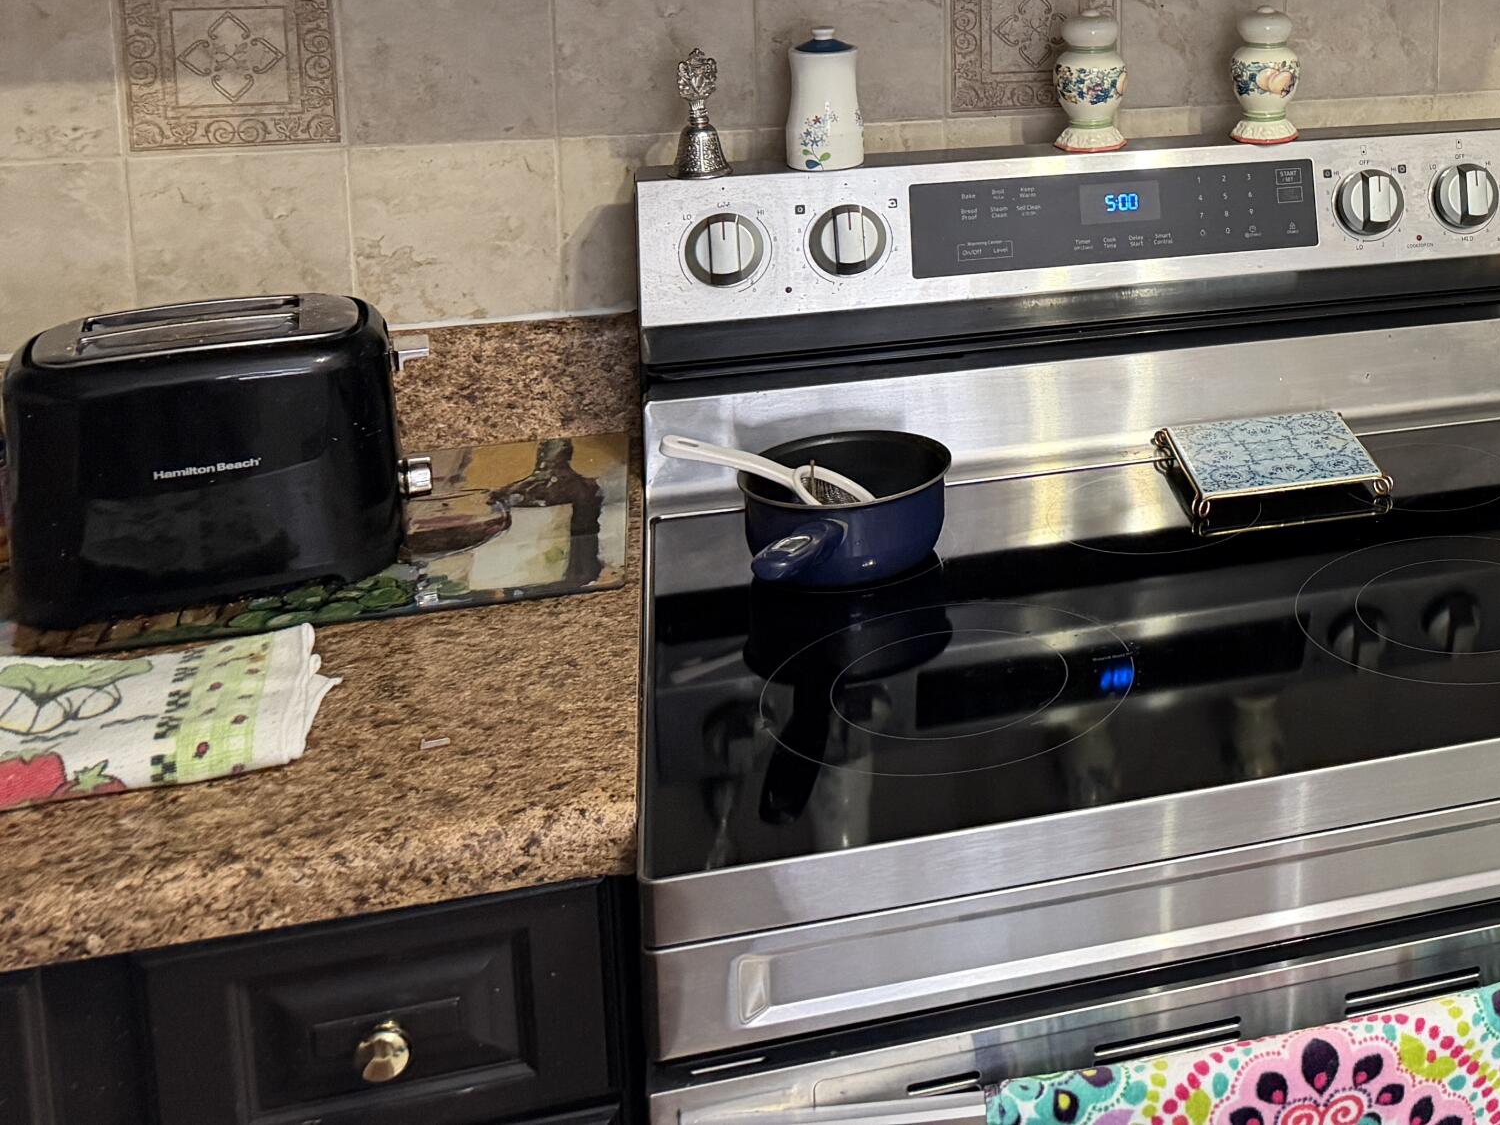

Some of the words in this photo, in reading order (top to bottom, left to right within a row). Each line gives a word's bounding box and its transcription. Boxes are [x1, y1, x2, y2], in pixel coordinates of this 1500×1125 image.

[1104, 193, 1138, 211] 5:00
[153, 465, 215, 480] Hamilton
[216, 458, 259, 472] Beach
